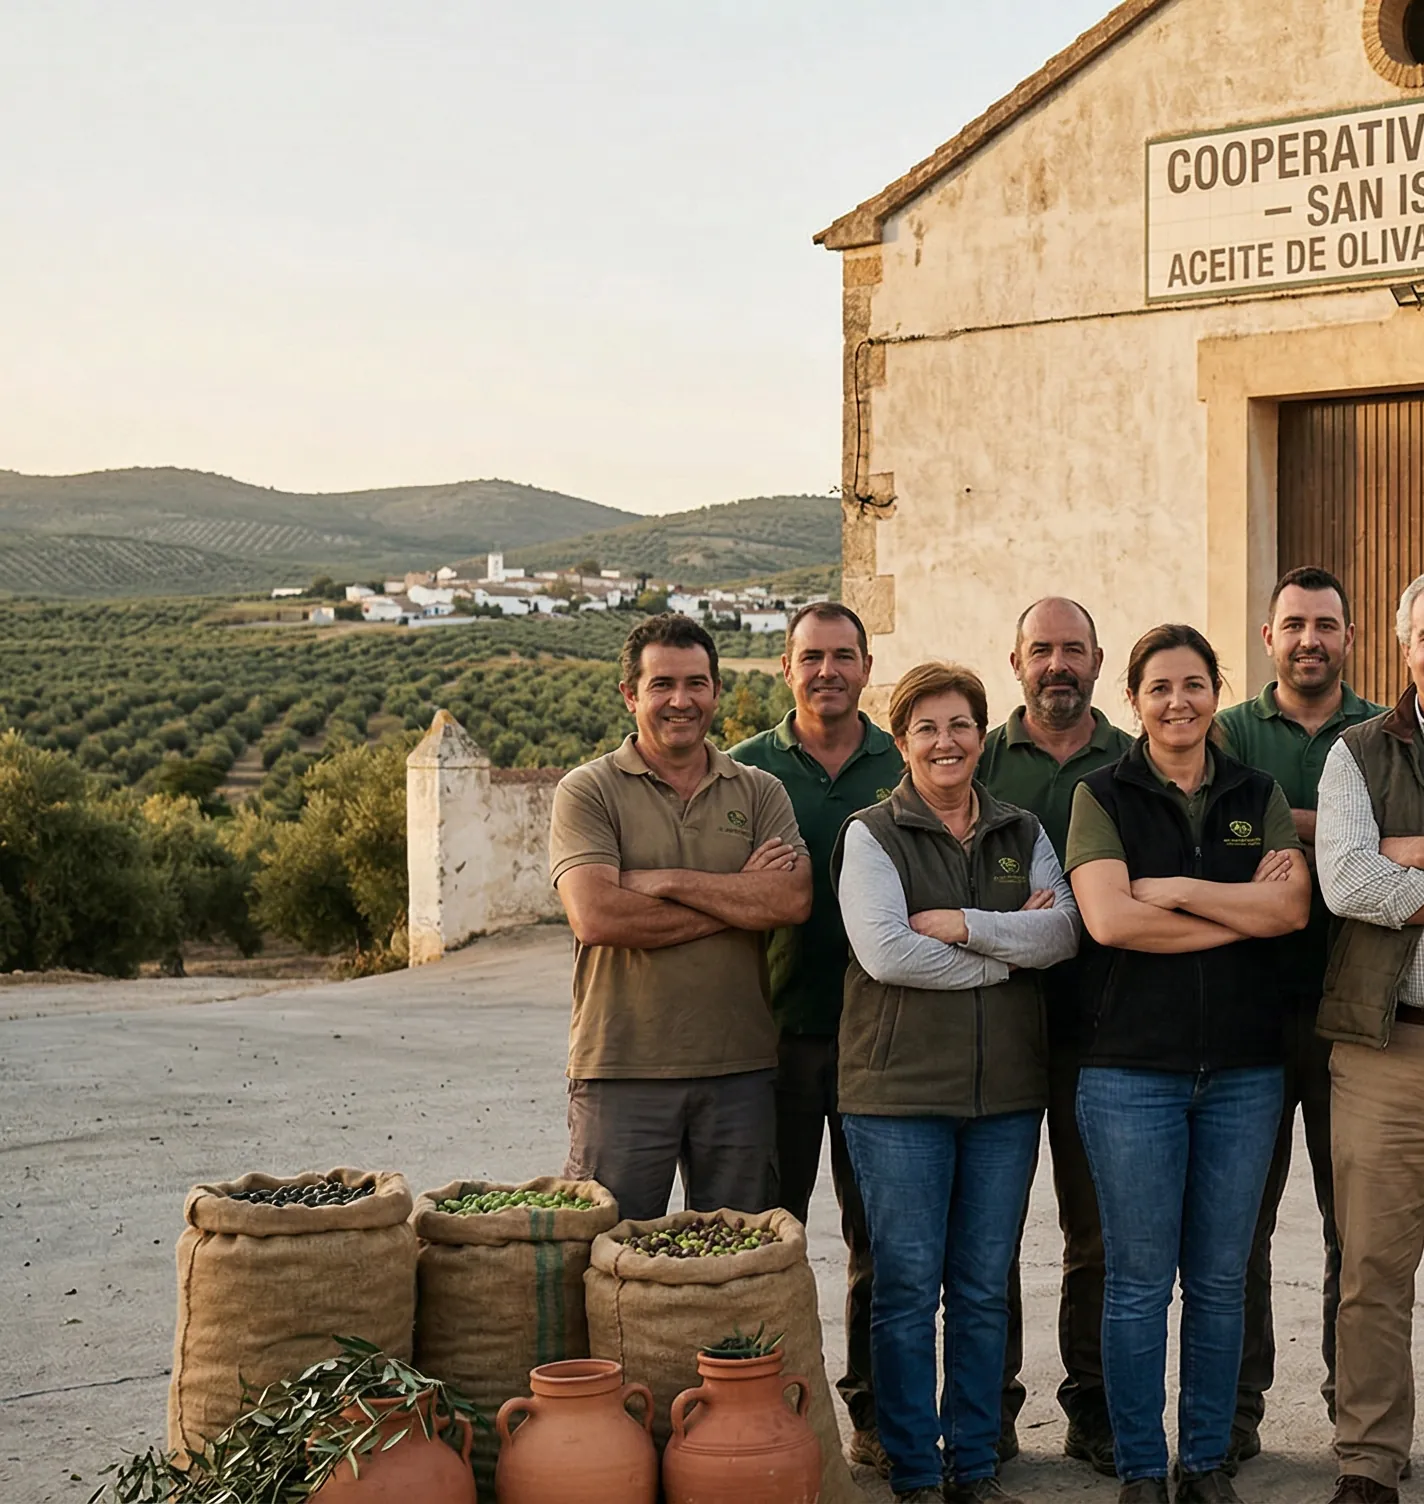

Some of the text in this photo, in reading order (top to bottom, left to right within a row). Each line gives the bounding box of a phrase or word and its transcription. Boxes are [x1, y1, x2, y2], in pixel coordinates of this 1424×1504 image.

[1307, 178, 1382, 226] SAN
[1168, 243, 1274, 287] ACEITE
[1287, 235, 1326, 274] DE
